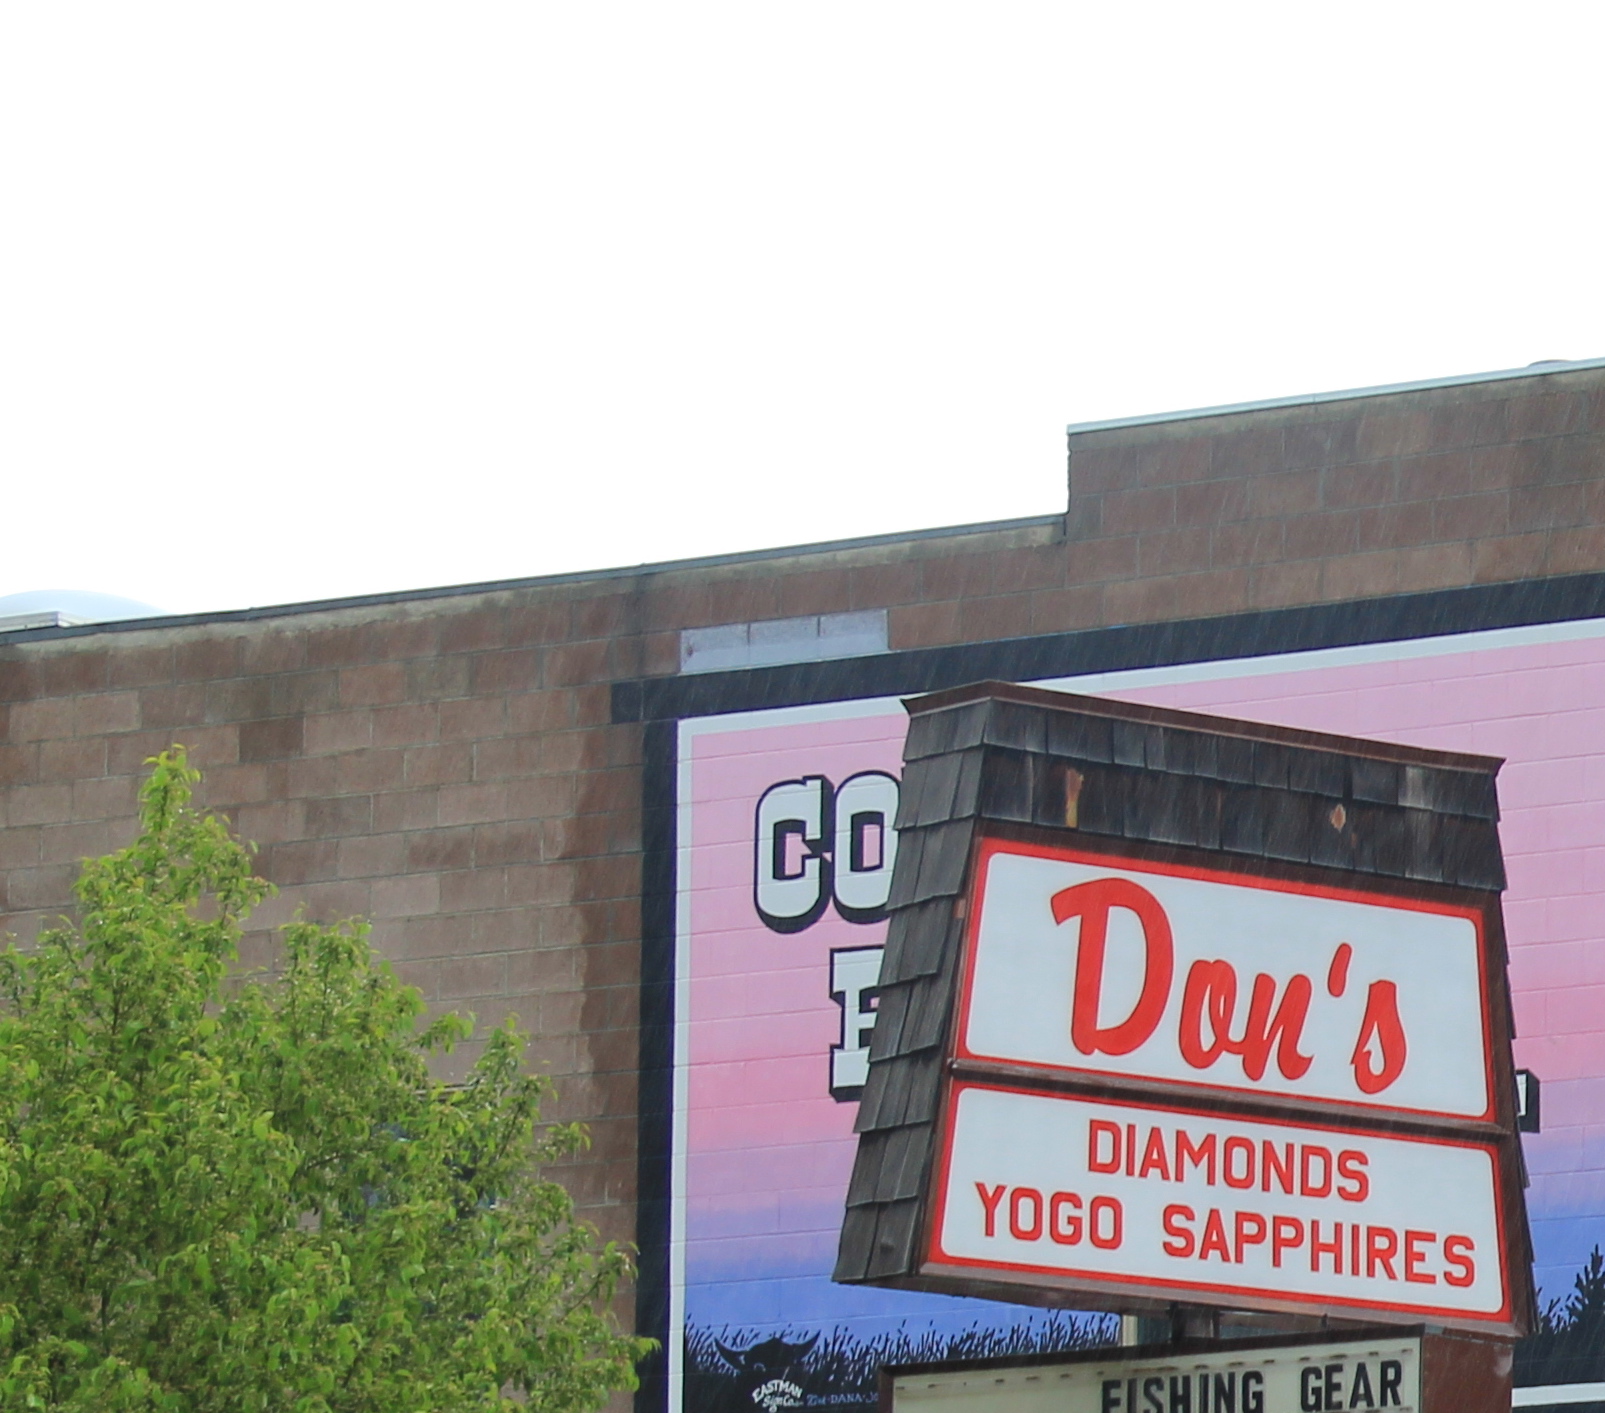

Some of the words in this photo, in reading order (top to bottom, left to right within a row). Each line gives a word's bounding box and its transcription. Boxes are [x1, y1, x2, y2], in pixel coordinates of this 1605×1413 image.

[1050, 877, 1407, 1094] Don's
[1087, 1119, 1370, 1204] DIAMONDS
[974, 1183, 1124, 1251] YOGO
[1162, 1204, 1476, 1289] SAPPHIRES
[752, 1380, 802, 1403] EASTMAN
[1299, 1359, 1402, 1412] GEAR
